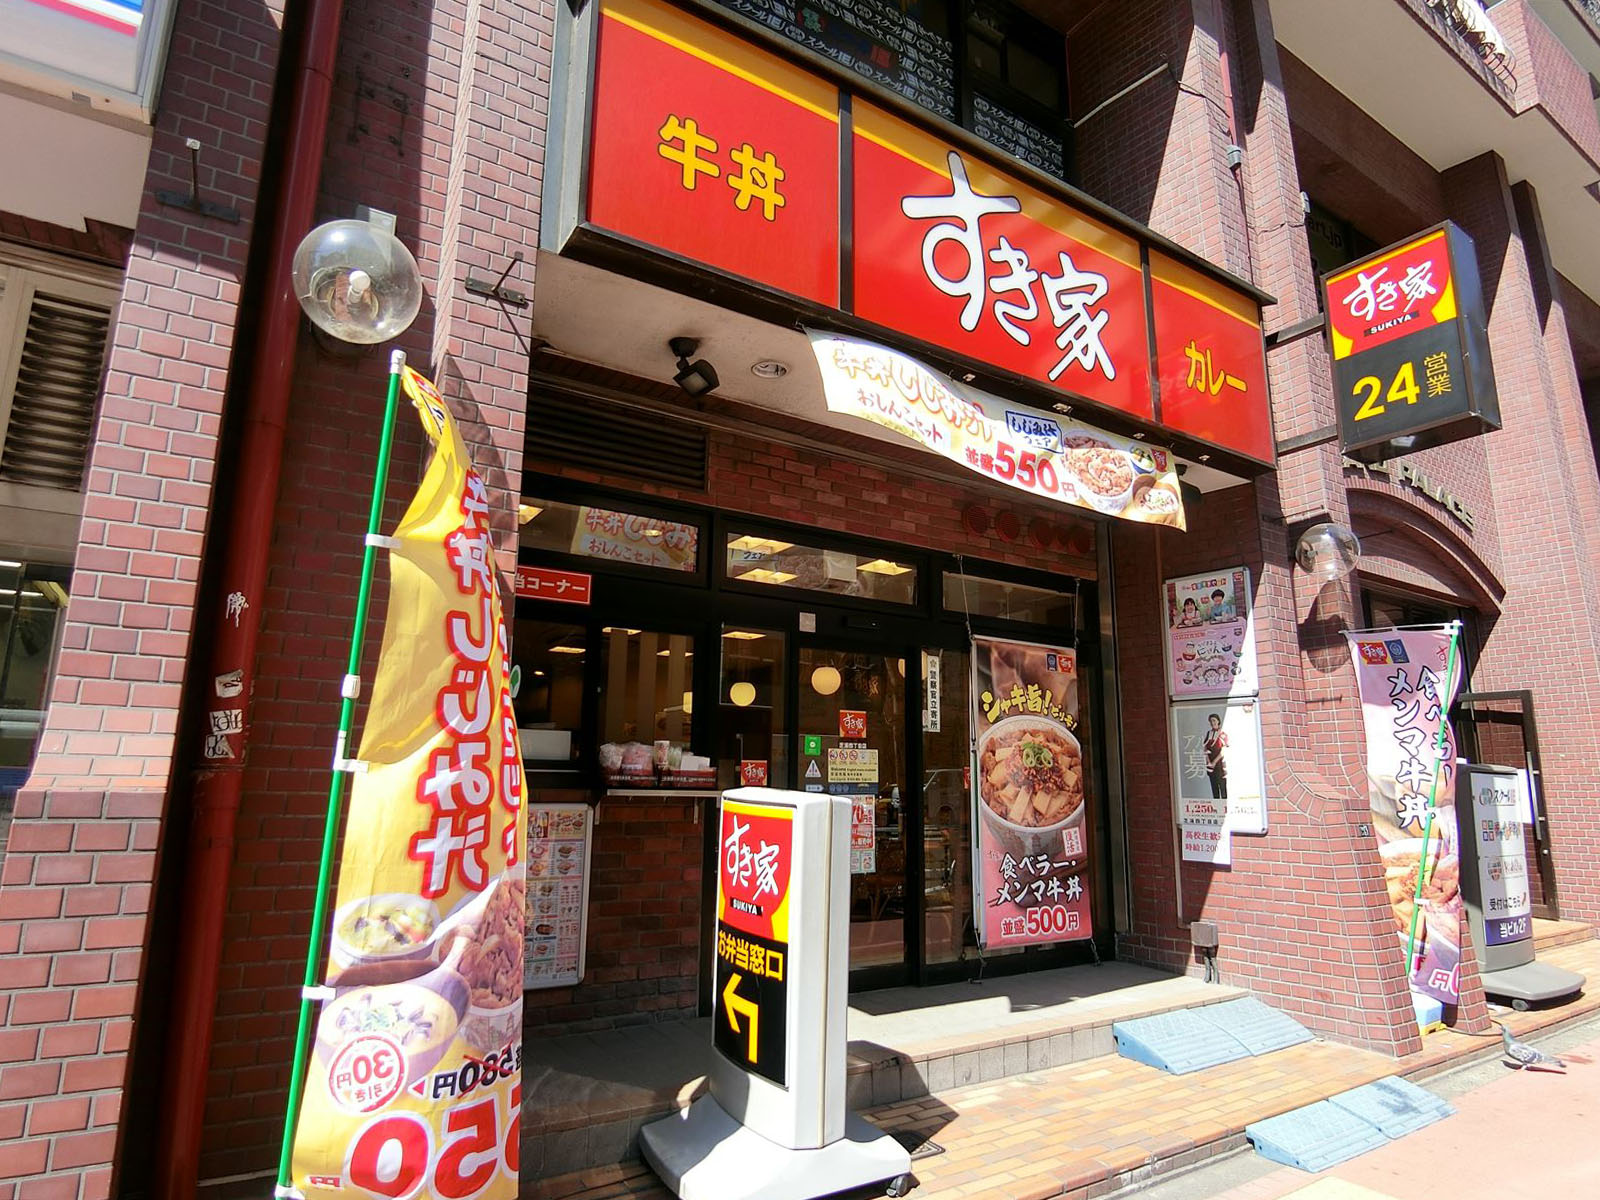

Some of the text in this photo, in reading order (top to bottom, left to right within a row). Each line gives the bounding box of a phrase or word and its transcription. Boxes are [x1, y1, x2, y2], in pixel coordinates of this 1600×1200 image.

[657, 114, 786, 221] 牛丼
[902, 151, 1117, 382] すき家
[1342, 260, 1437, 321] すき家
[1370, 313, 1413, 335] SUKIYA
[1184, 340, 1248, 396] カレー
[1351, 362, 1421, 423] 24
[1424, 351, 1451, 398] 営業
[857, 387, 943, 441] おしんこセット
[588, 538, 662, 565] おしんこセット
[930, 670, 938, 729] 警察官立寄所
[1386, 667, 1436, 831] メンマ牛丼
[725, 814, 779, 900] すき家
[733, 898, 758, 916] SUKIYA
[996, 875, 1084, 905] メンマ牛丼
[1001, 905, 1080, 937] 並盛 500円
[718, 929, 783, 982] お弁当窓口
